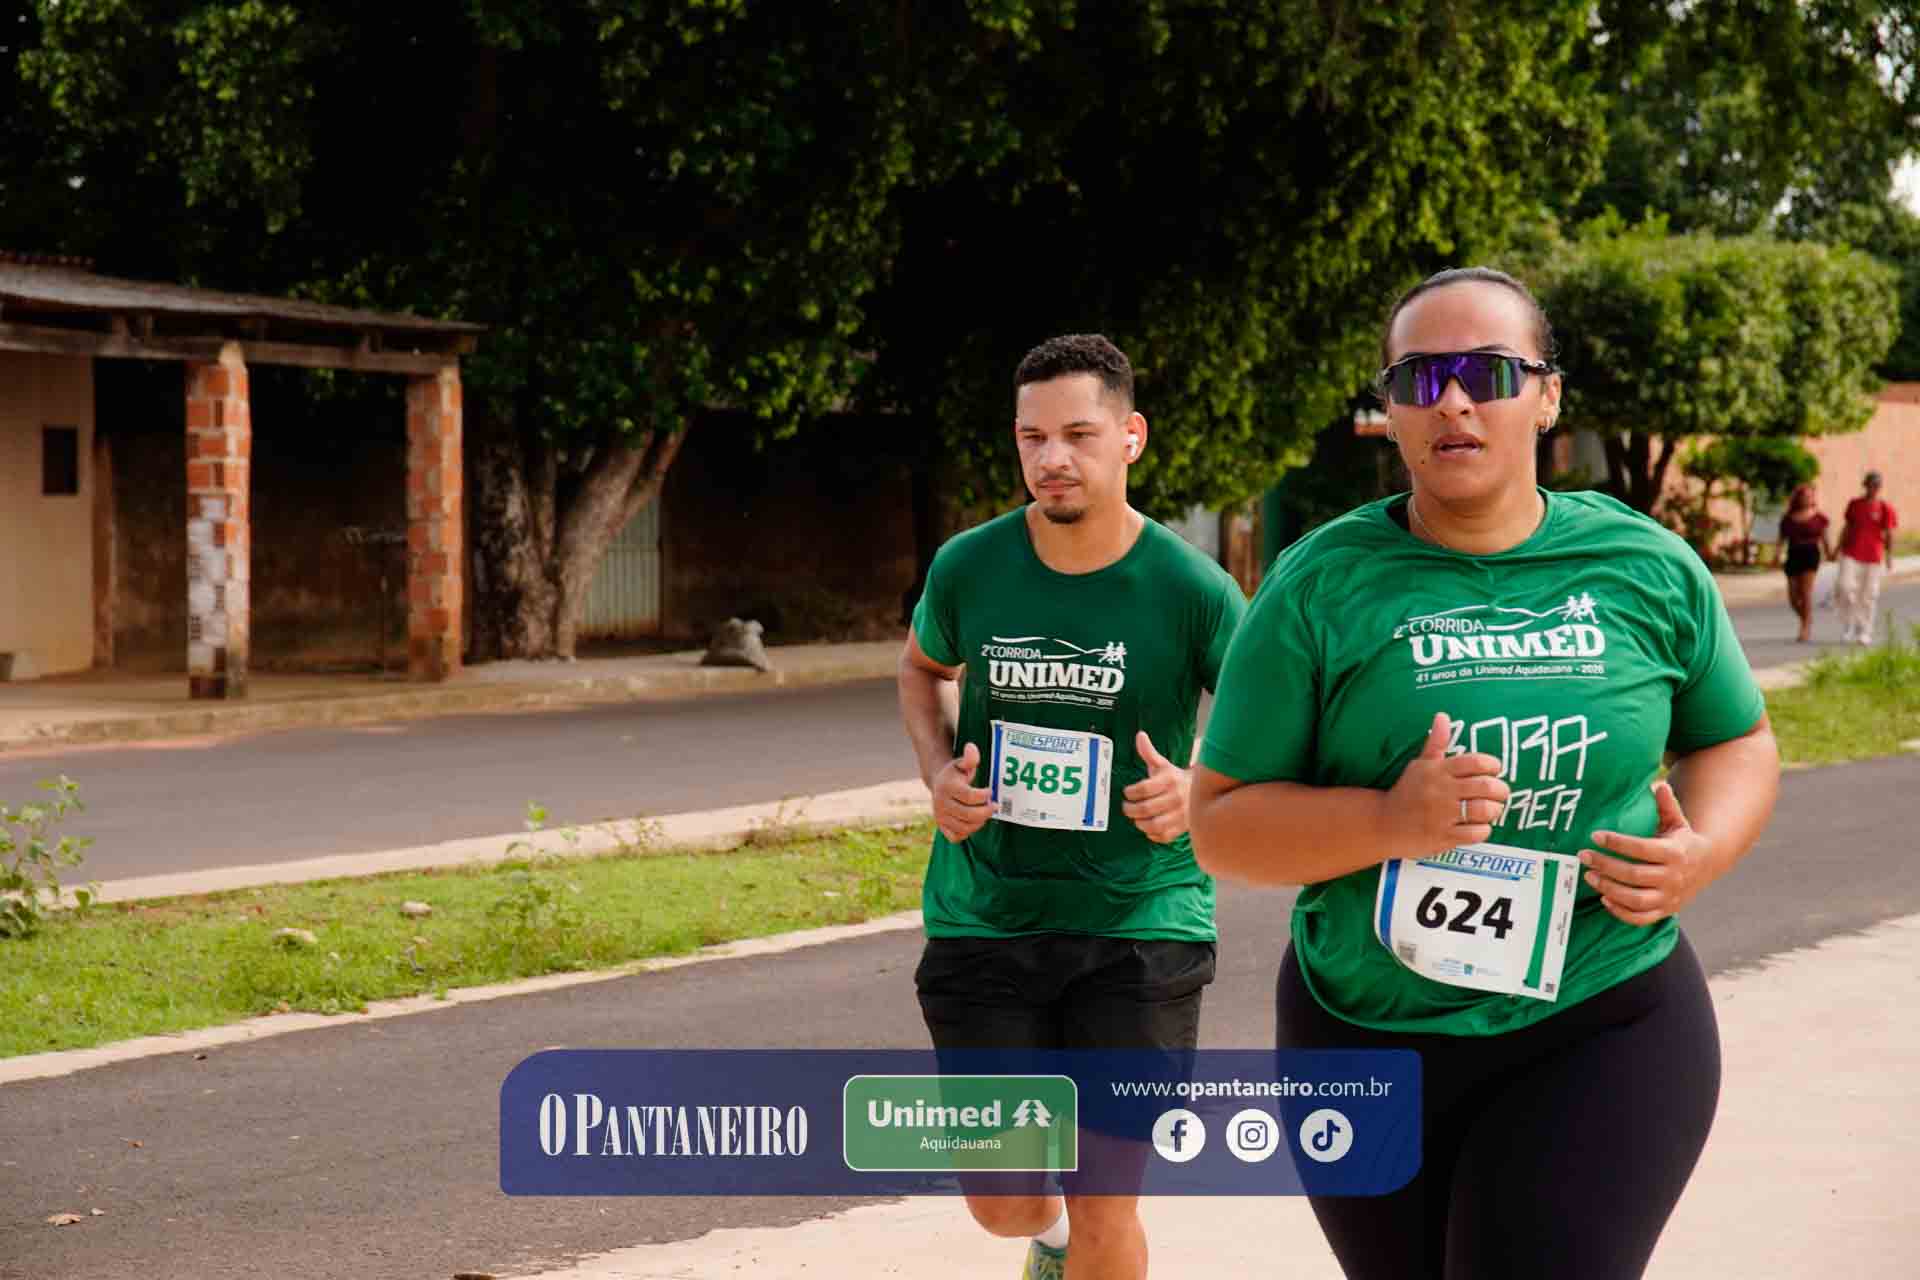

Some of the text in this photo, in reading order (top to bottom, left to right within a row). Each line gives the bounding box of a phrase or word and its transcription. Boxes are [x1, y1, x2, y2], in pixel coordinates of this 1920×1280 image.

[1409, 618, 1485, 634] CORRIDA
[1409, 624, 1605, 666] UNIMED
[990, 645, 1042, 660] CORRIDA
[988, 659, 1125, 694] UNIMED
[1002, 755, 1083, 796] 3485
[1415, 886, 1513, 939] 624
